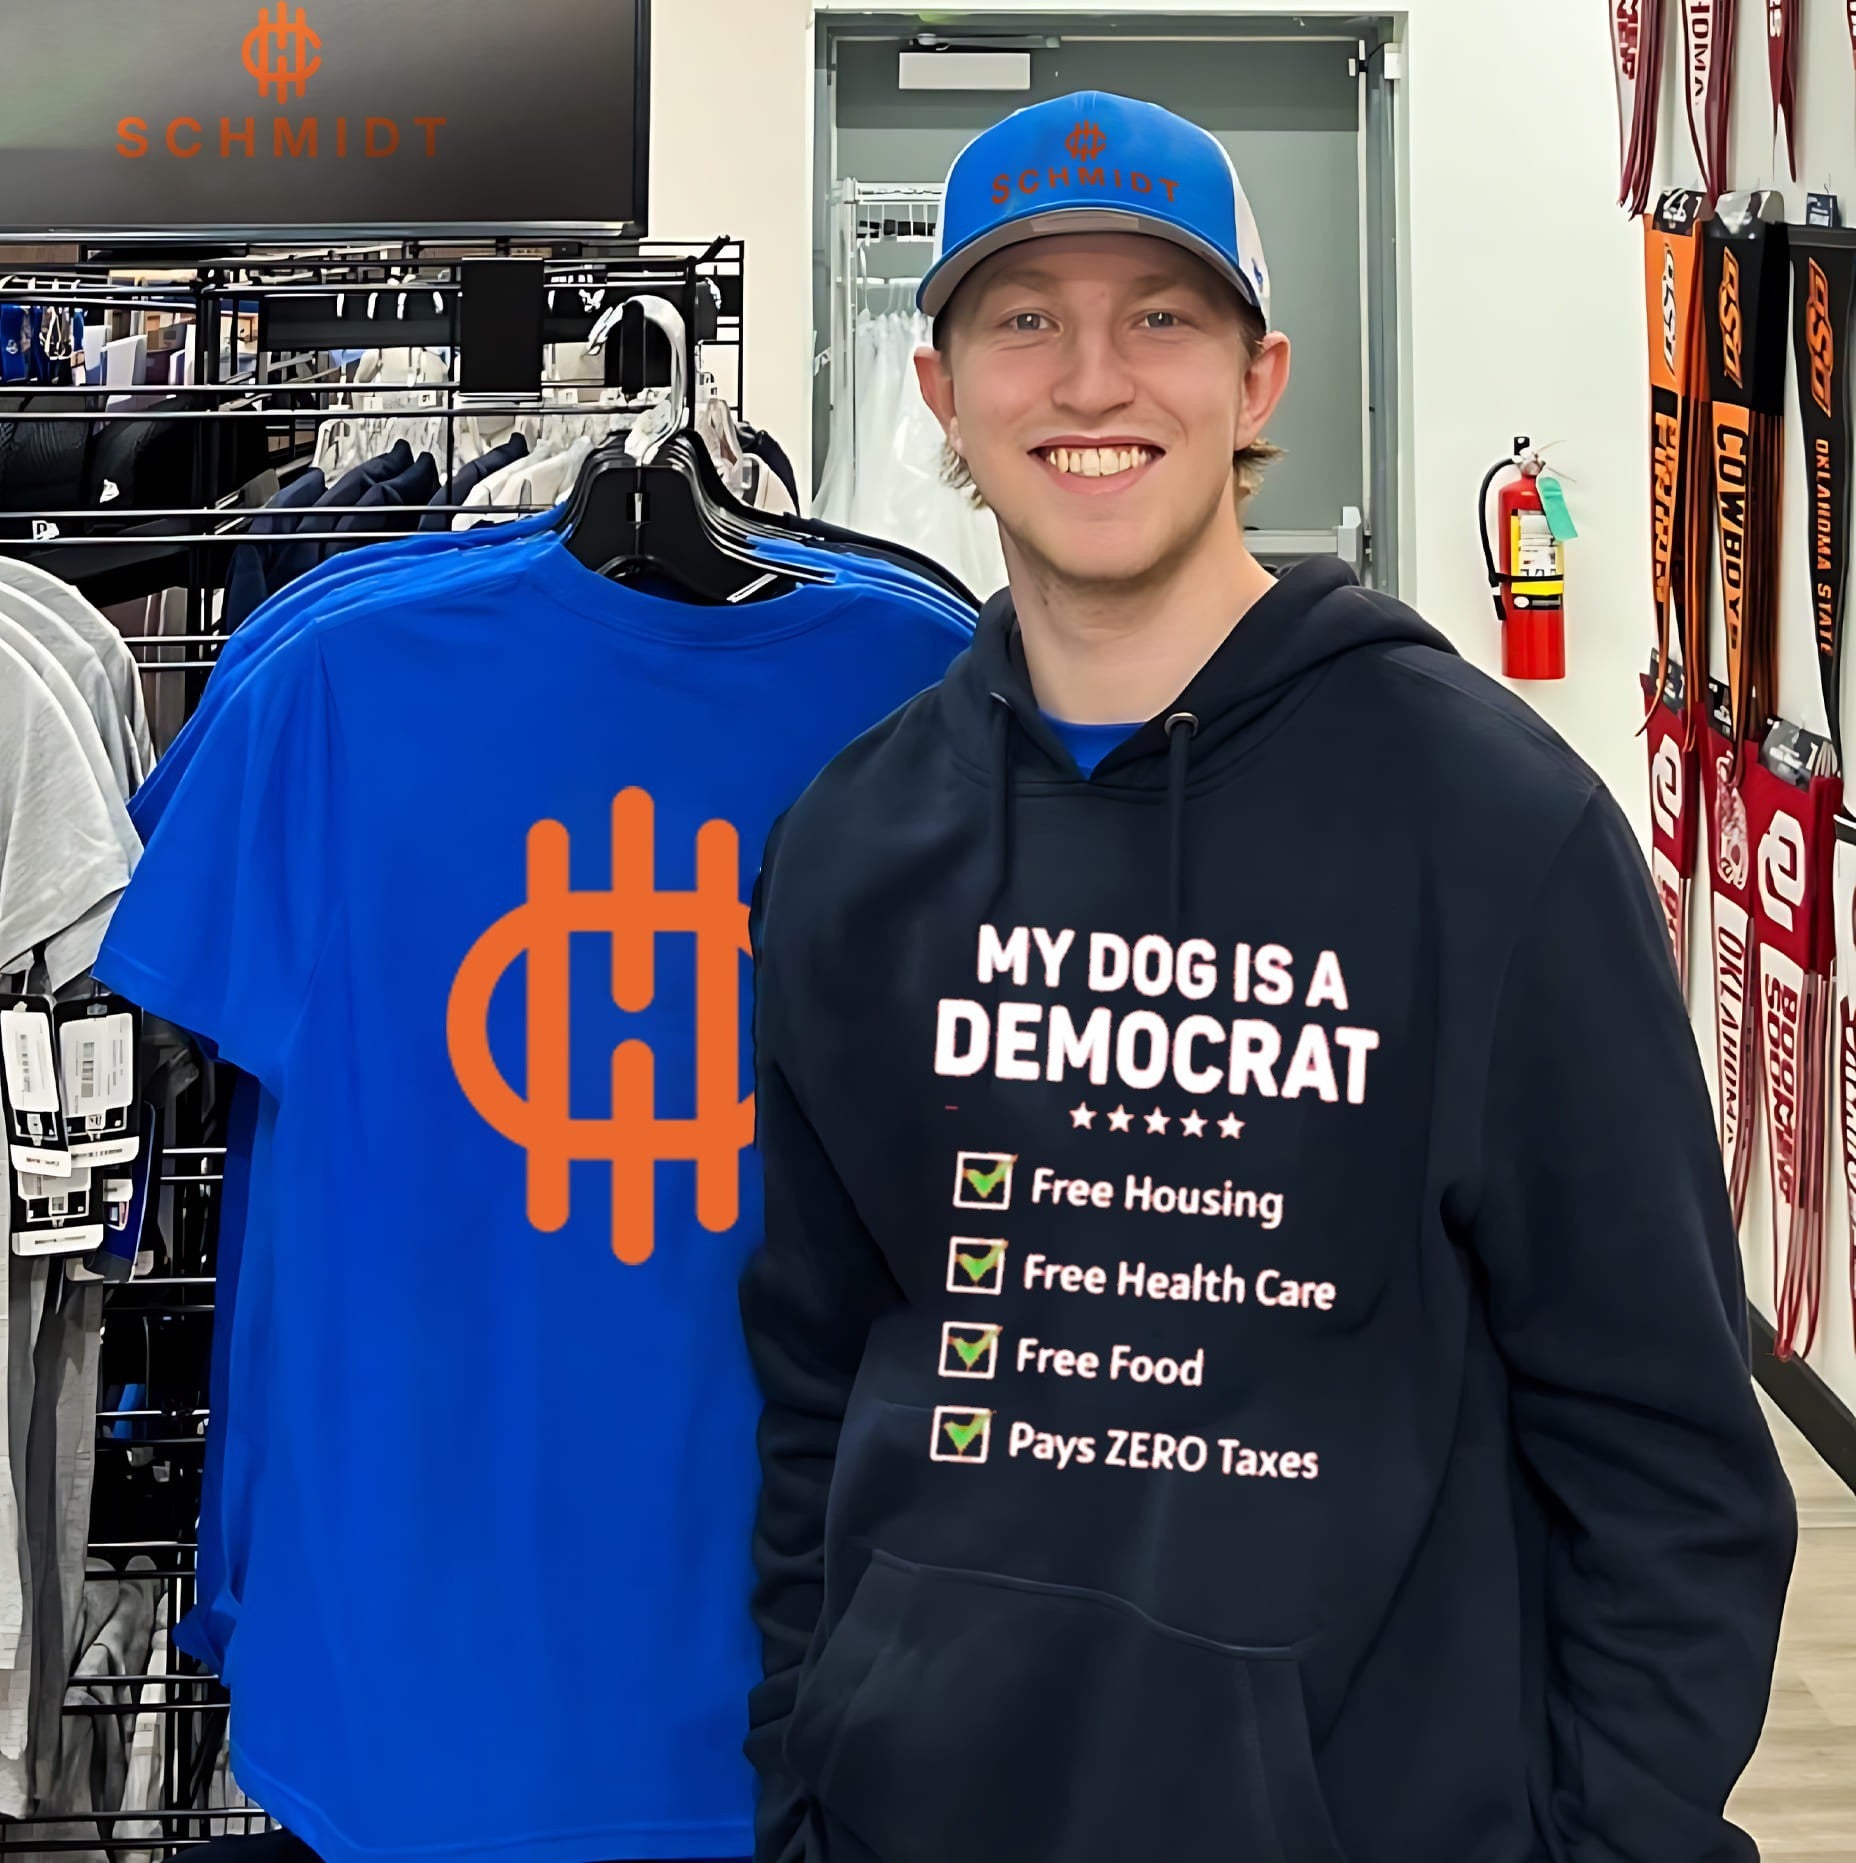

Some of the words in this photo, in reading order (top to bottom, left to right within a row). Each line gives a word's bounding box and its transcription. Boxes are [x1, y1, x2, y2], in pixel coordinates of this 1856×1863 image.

[115, 116, 447, 158] SCHMIDT
[991, 167, 1179, 204] SCHMIDT
[1815, 438, 1832, 570] OKLAHOMA
[977, 924, 1075, 987] MY
[1088, 932, 1217, 1000] DOG
[1234, 943, 1293, 1005] IS
[1305, 950, 1348, 1010] A
[934, 998, 1379, 1104] DEMOCRAT
[1032, 1168, 1113, 1208] Free
[1125, 1175, 1283, 1229] Housing
[1024, 1254, 1107, 1294] Free
[1117, 1261, 1245, 1303] Health
[1256, 1269, 1336, 1310] Care
[1017, 1338, 1099, 1378] Free
[1110, 1345, 1204, 1386] Food
[1009, 1422, 1095, 1469] Pays
[1105, 1430, 1207, 1472] ZERO
[1218, 1439, 1318, 1479] Taxes
